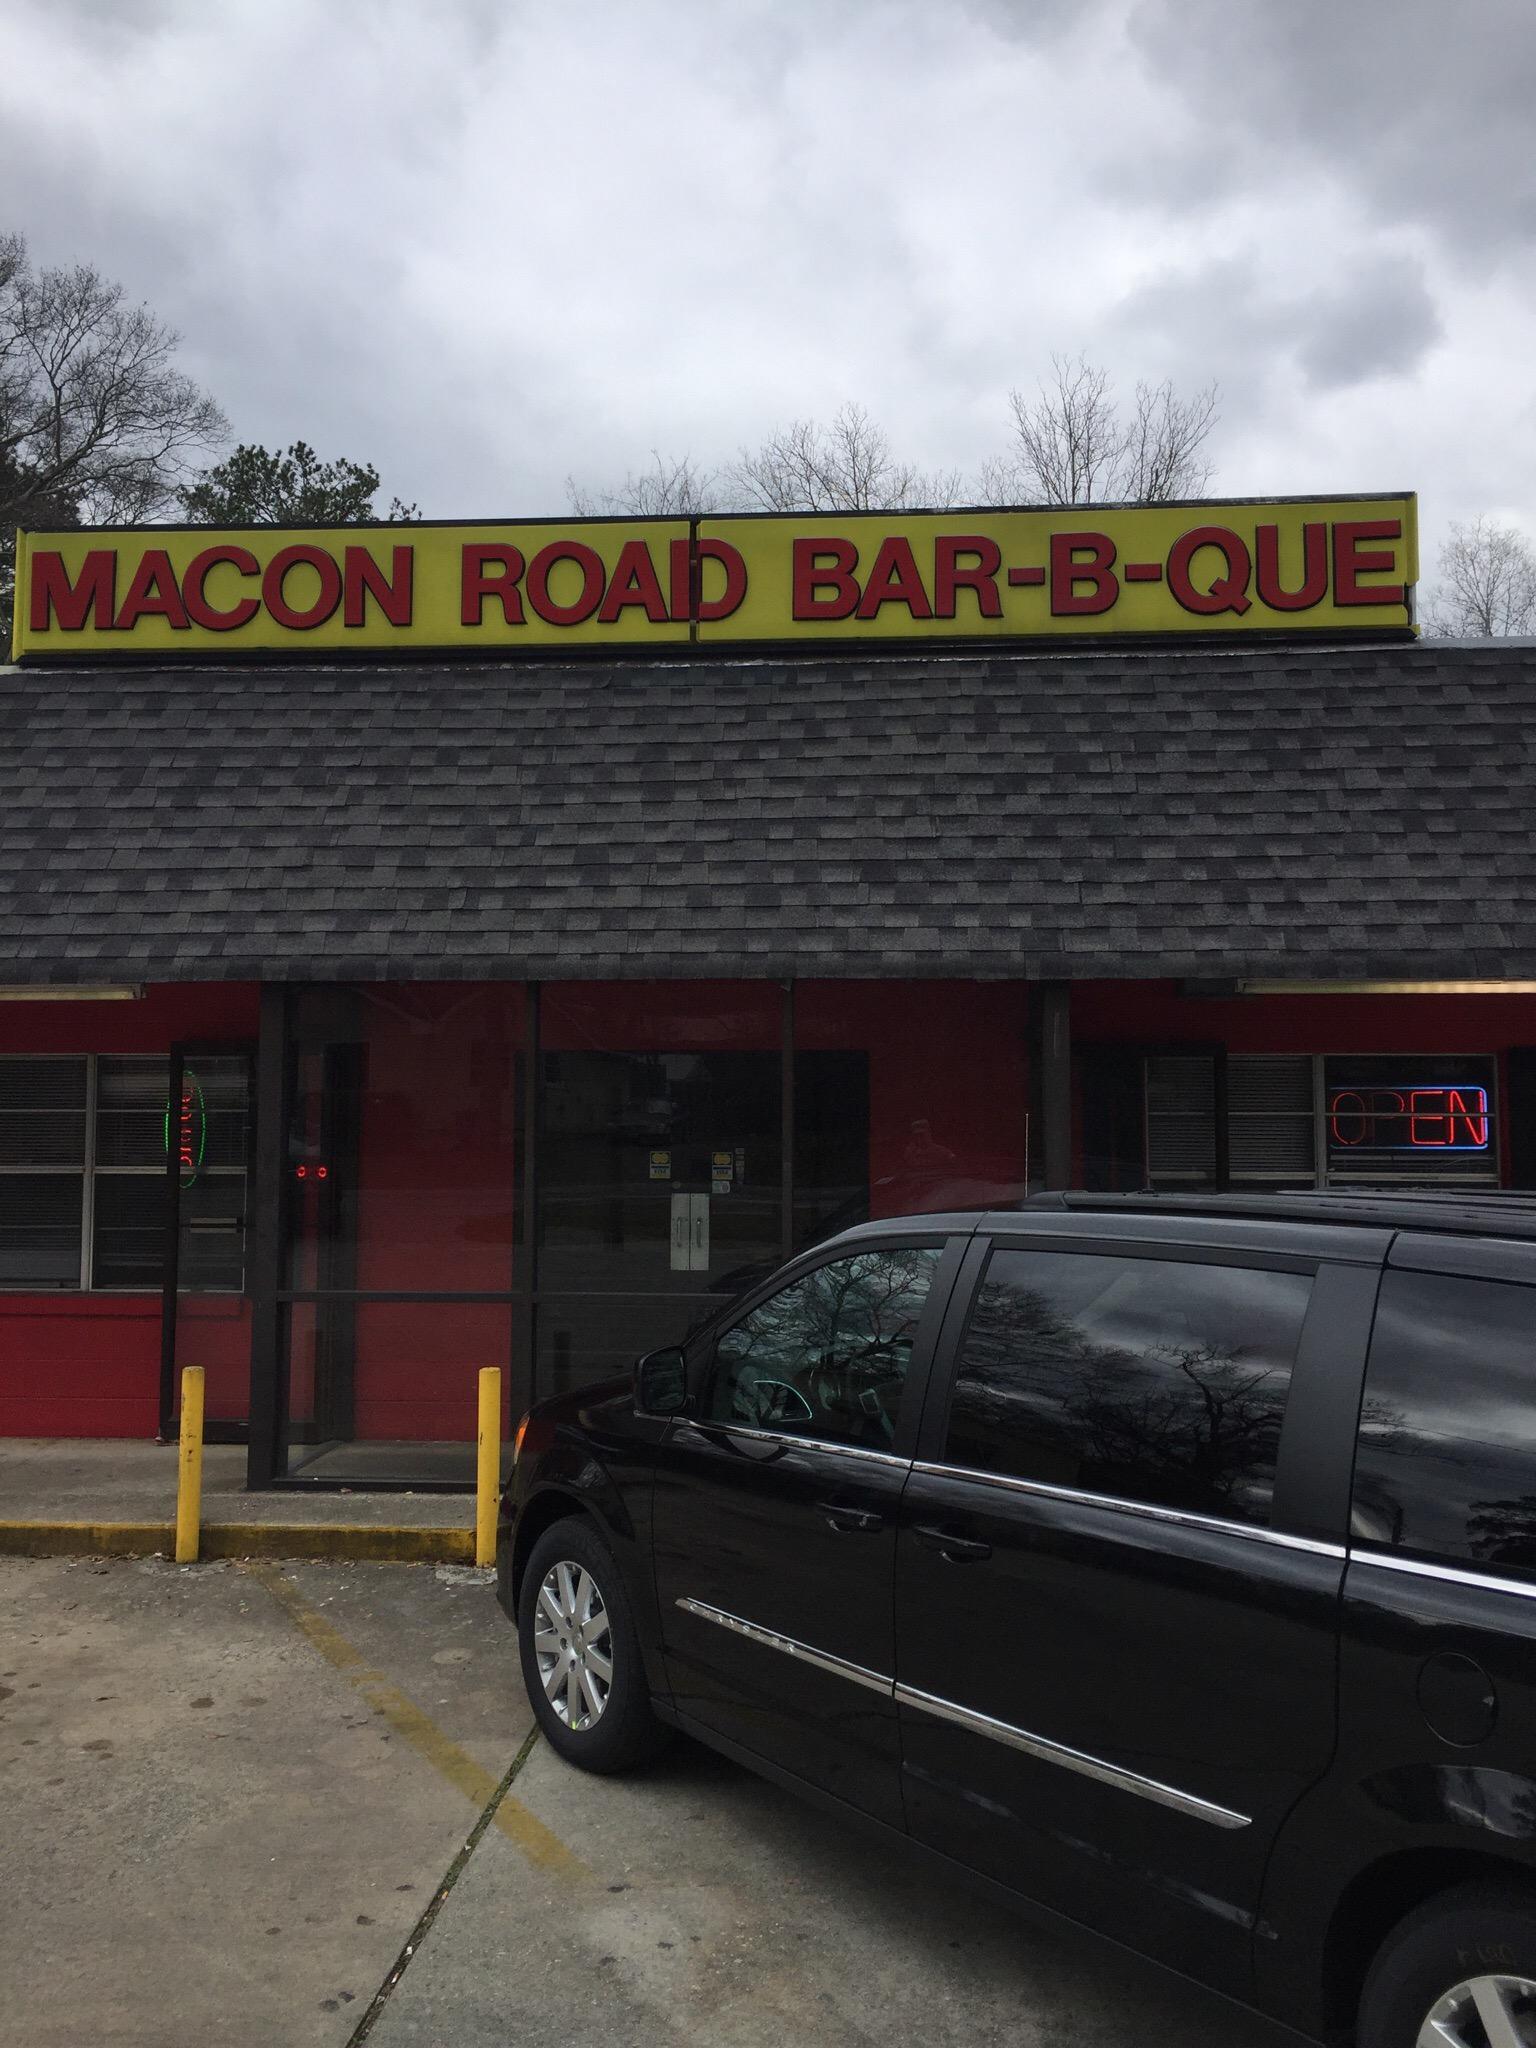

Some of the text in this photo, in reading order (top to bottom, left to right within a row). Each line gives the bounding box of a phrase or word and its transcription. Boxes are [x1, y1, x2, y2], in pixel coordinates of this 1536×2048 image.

[30, 519, 1406, 631] MACON ROAD BAR-B-QUE
[1333, 1090, 1486, 1144] OPEN
